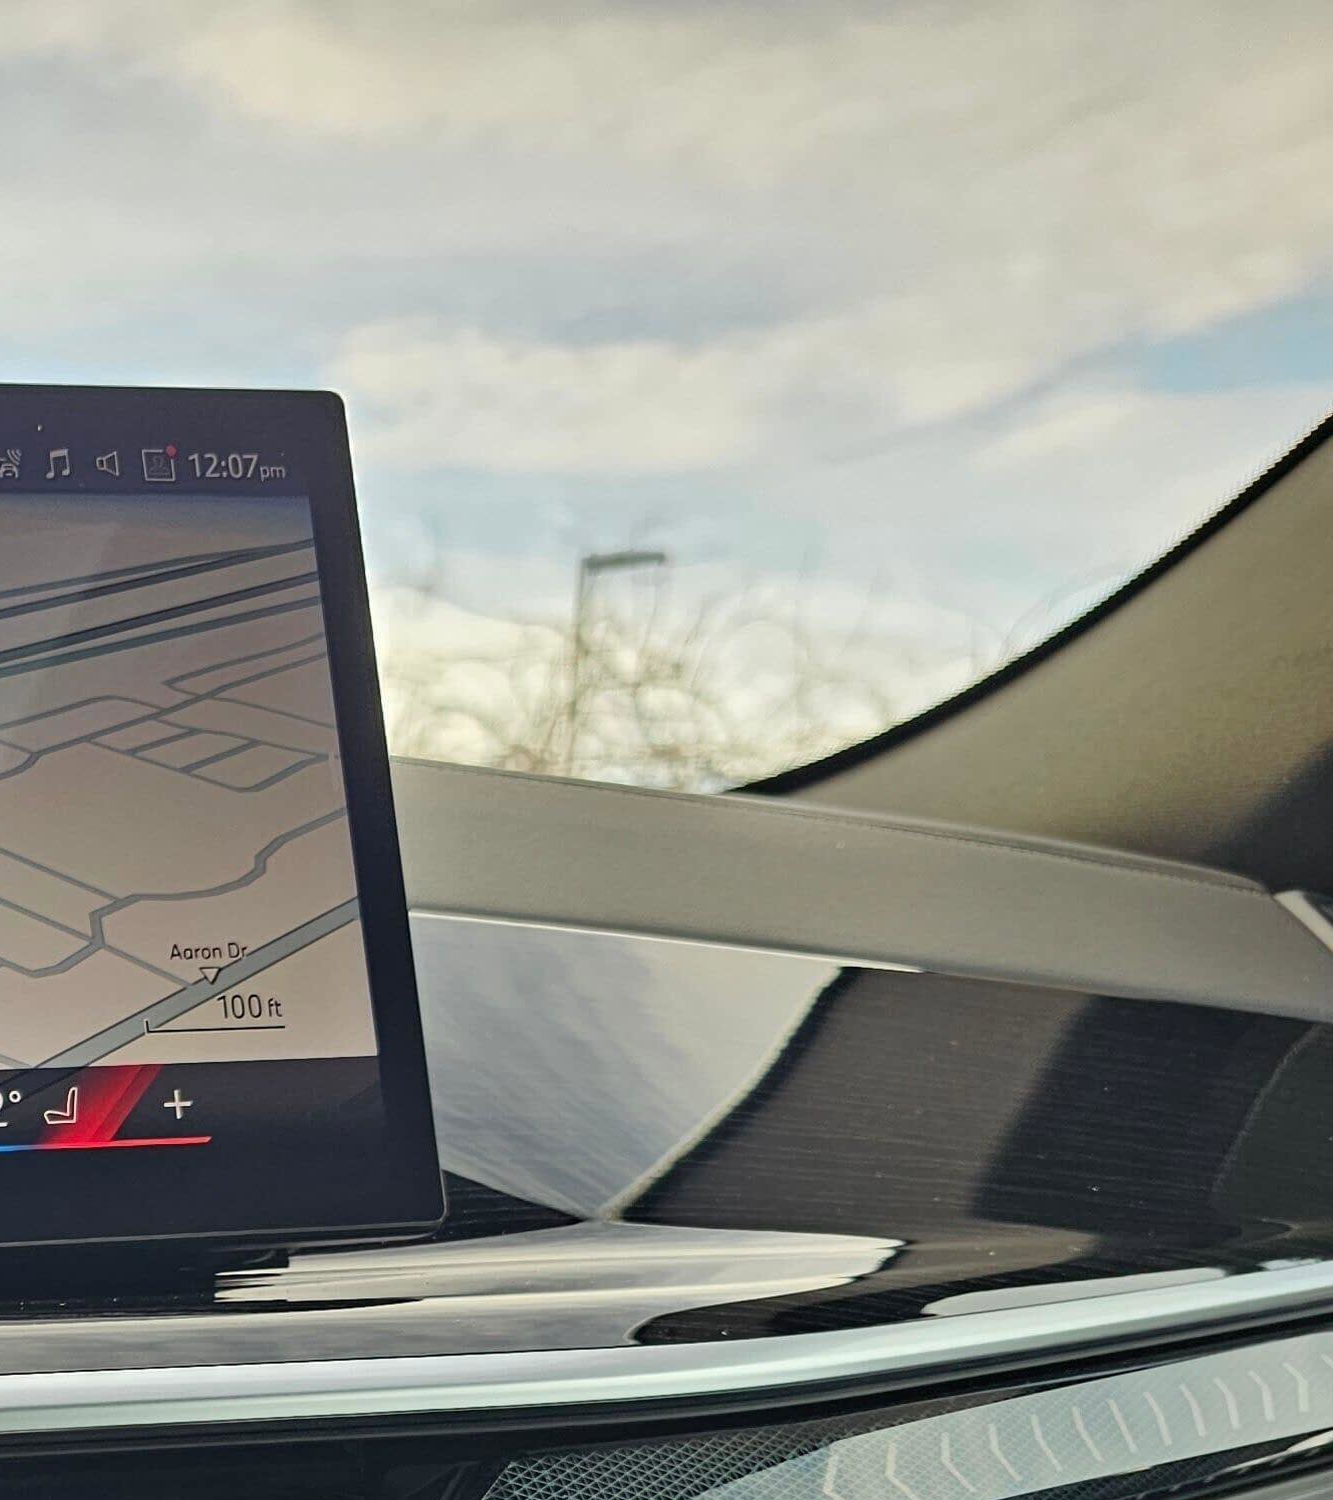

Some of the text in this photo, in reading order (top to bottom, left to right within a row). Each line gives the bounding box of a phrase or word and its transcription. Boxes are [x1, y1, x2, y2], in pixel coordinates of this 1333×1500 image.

[169, 943, 222, 960] Aaron
[216, 994, 283, 1019] 100 ft
